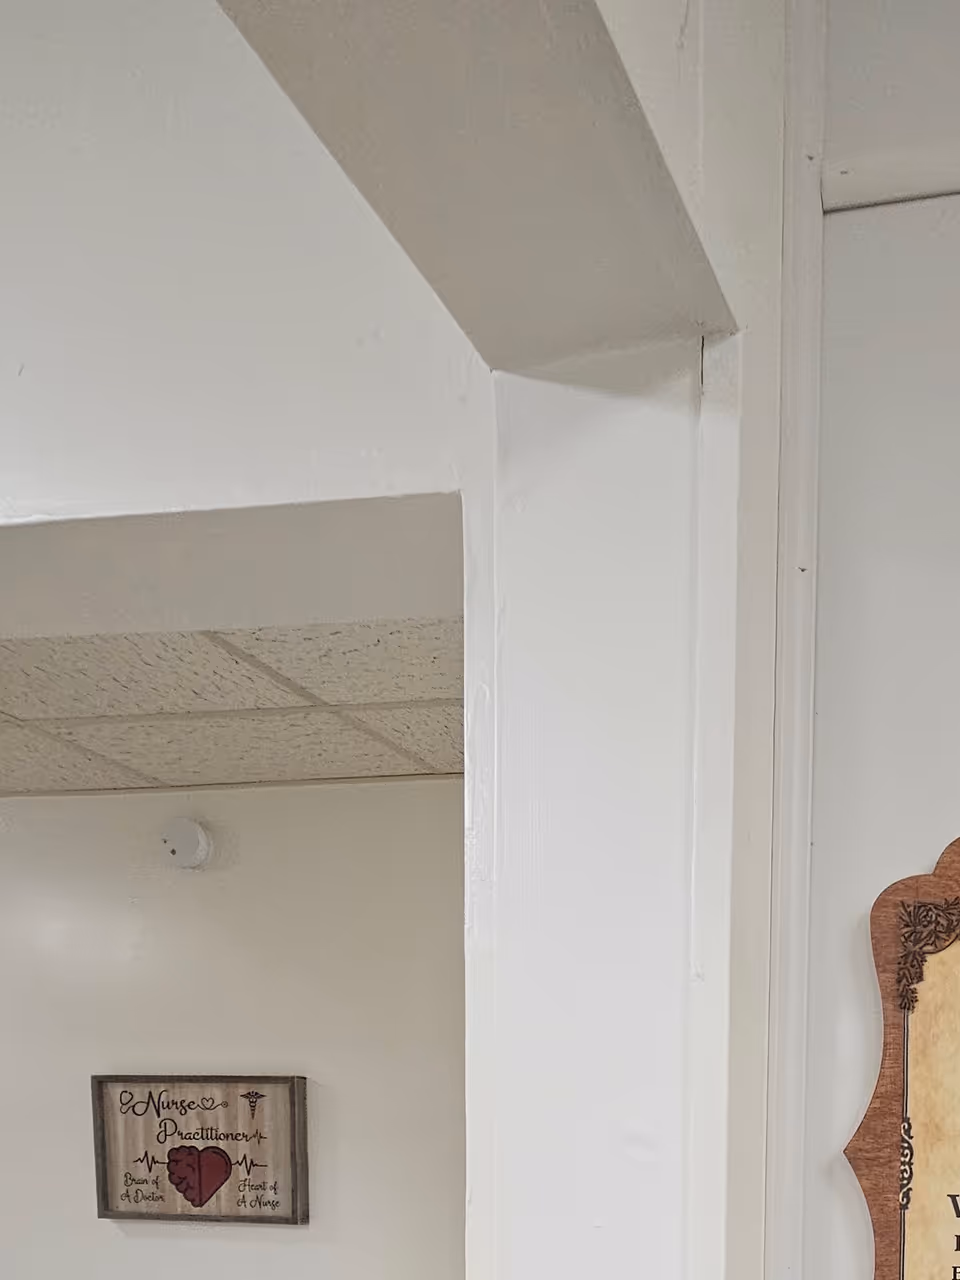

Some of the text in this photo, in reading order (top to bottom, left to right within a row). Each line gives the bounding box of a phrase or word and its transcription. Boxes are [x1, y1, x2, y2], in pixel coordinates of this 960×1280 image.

[131, 1089, 197, 1119] Nurse
[156, 1118, 251, 1144] Practitioner
[123, 1172, 160, 1189] Brain of
[237, 1178, 279, 1195] Heart of
[120, 1189, 166, 1204] A Doctor
[236, 1194, 281, 1210] A Nurse
